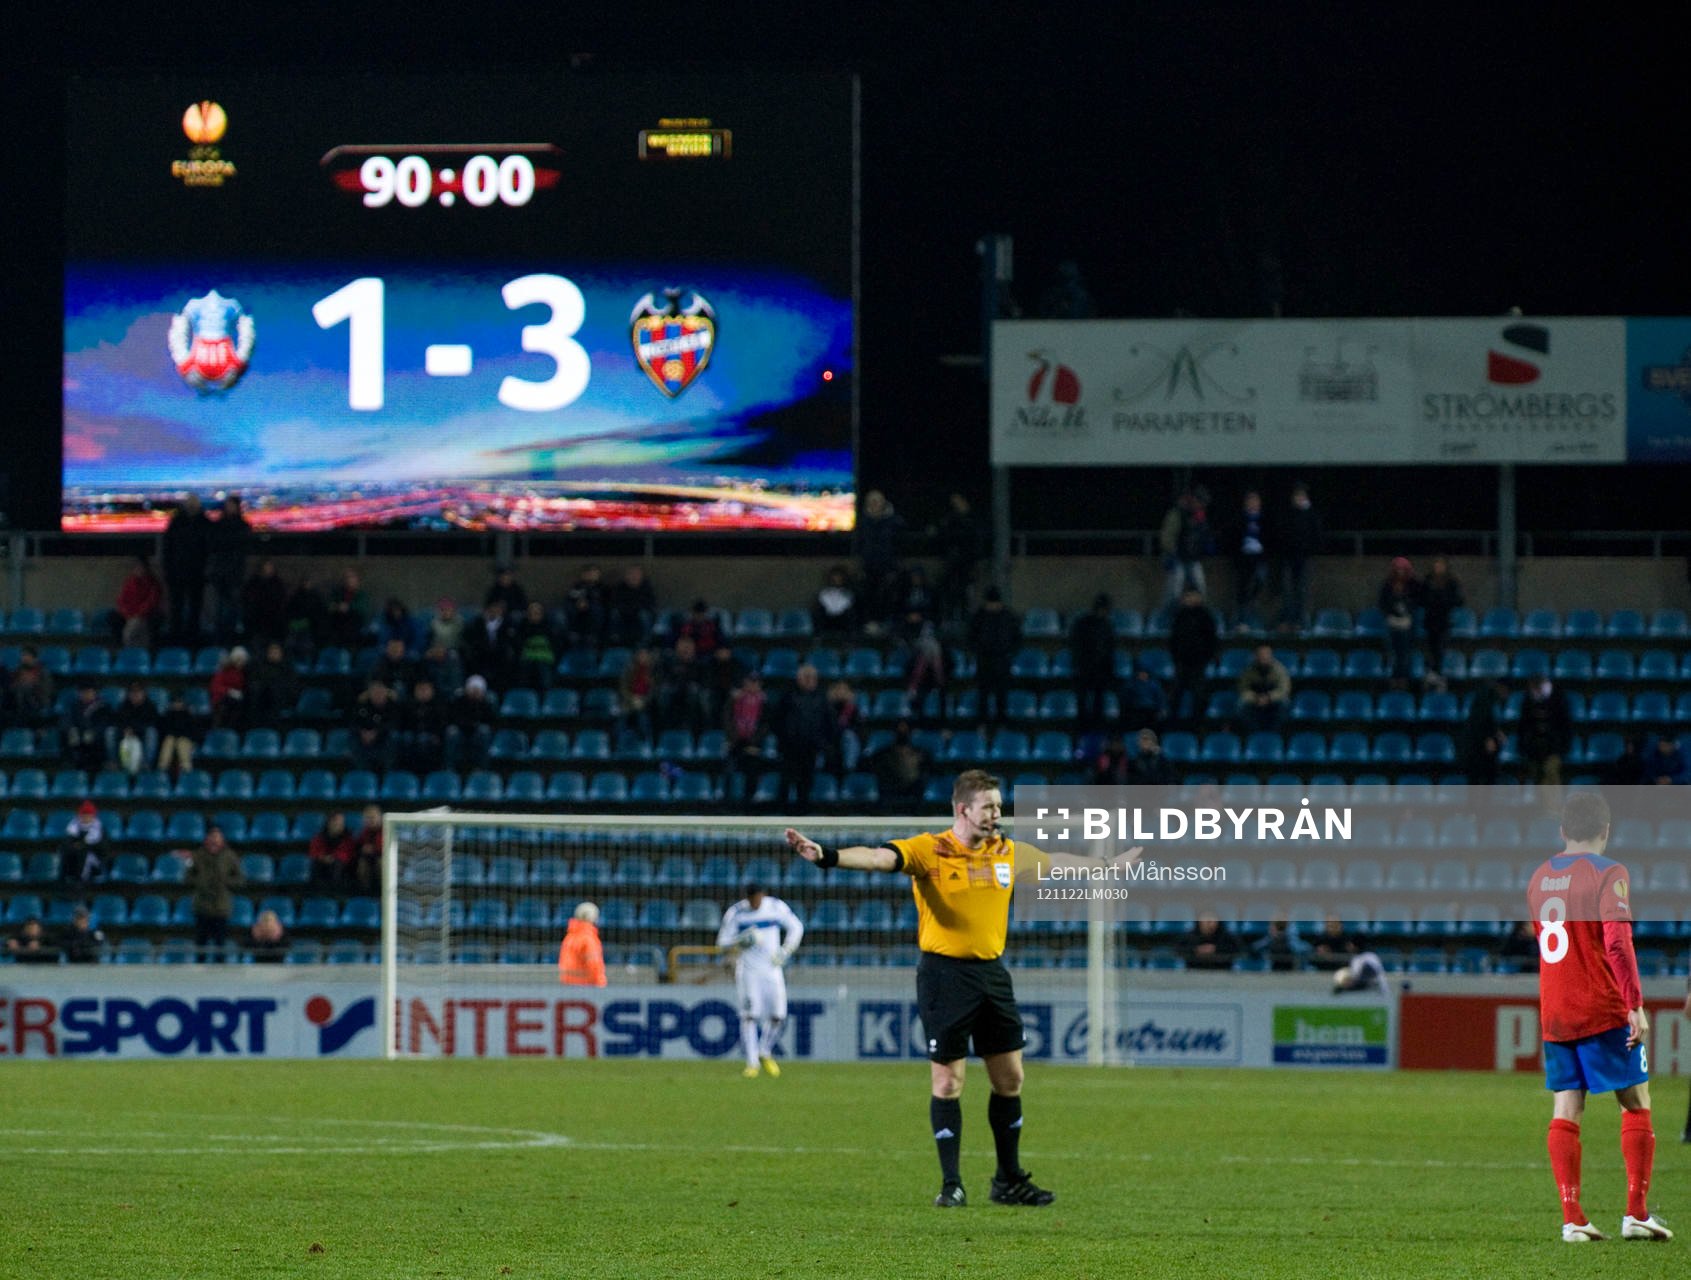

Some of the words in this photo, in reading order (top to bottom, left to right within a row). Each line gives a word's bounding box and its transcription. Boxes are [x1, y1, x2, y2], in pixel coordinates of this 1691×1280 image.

[360, 154, 536, 208] 90:00
[312, 277, 384, 411] 1
[425, 344, 473, 376] -
[498, 273, 591, 412] 3
[1112, 411, 1257, 433] PARAPETEN
[1540, 897, 1569, 964] 8
